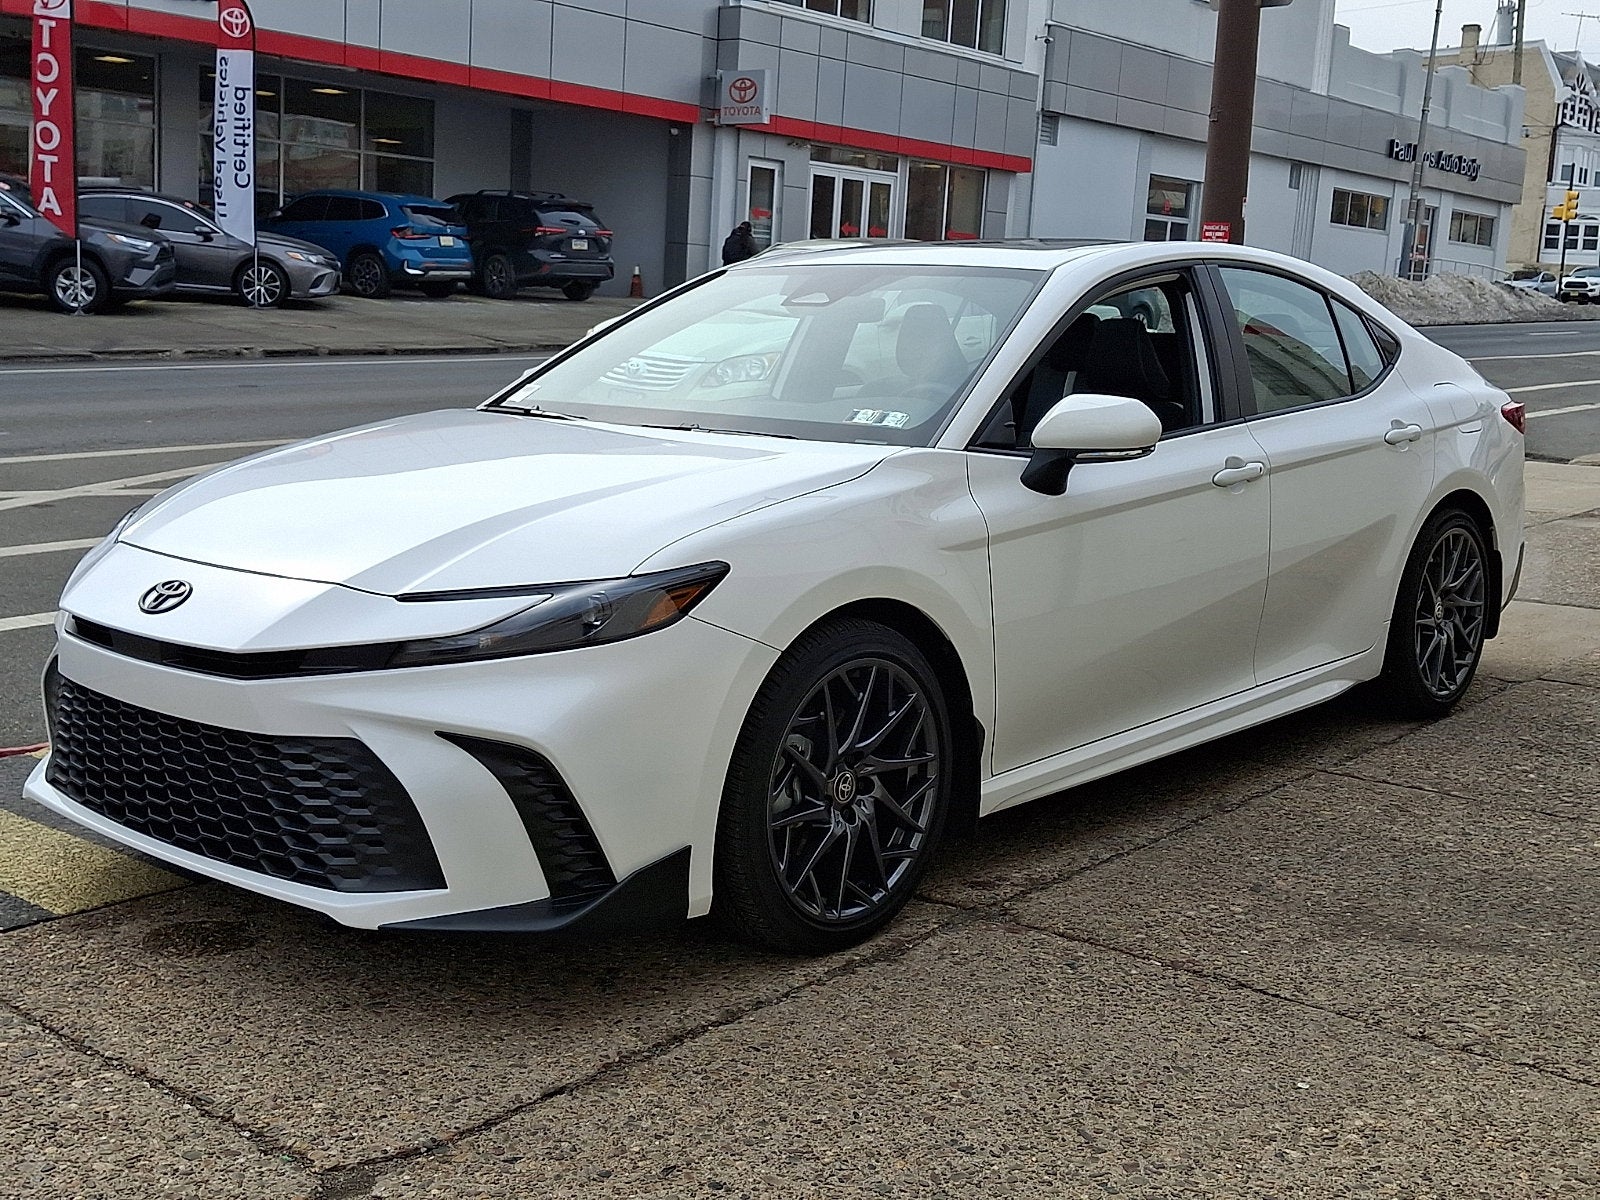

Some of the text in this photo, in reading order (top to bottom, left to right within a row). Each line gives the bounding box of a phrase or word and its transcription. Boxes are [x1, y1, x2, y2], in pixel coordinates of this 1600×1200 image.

[35, 18, 62, 217] TOYOTA
[722, 105, 761, 117] TOYOTA
[1391, 139, 1415, 164] Paul
[1438, 151, 1460, 173] Auto
[1460, 155, 1483, 182] Body
